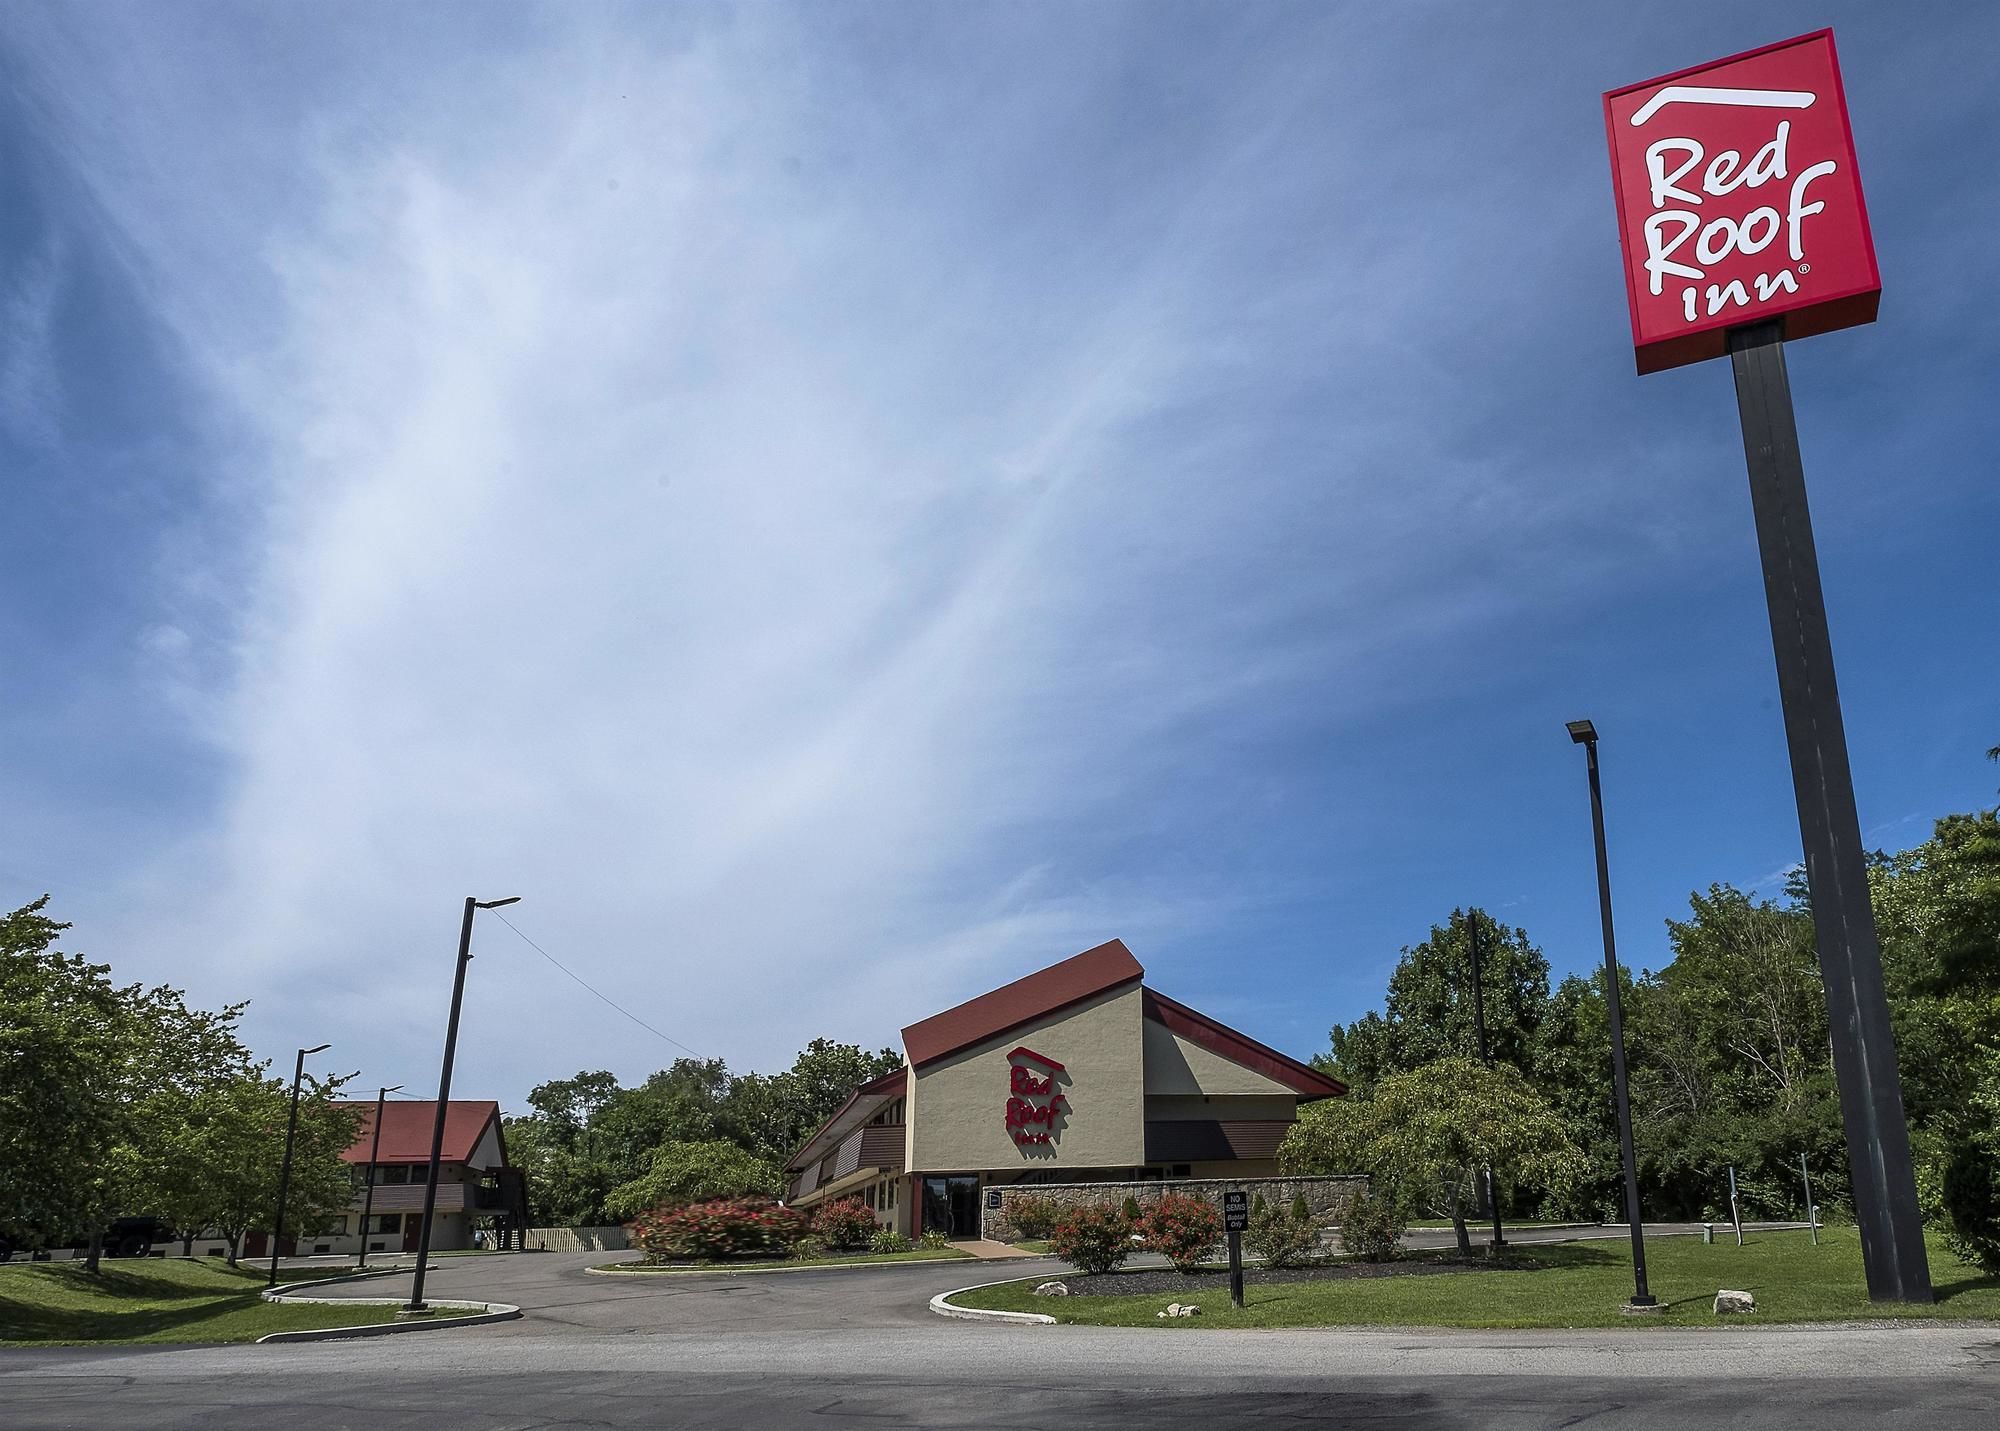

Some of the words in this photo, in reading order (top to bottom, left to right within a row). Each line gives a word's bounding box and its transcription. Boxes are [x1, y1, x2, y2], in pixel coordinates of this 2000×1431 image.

[1645, 120, 1791, 208] Red
[1643, 160, 1837, 296] Roof
[1682, 269, 1799, 322] inn
[1010, 1065, 1054, 1096] Red
[1005, 1094, 1065, 1130] Roof
[1226, 1203, 1246, 1212] SEMIS
[1230, 1195, 1240, 1203] NO
[1230, 1221, 1242, 1229] Only
